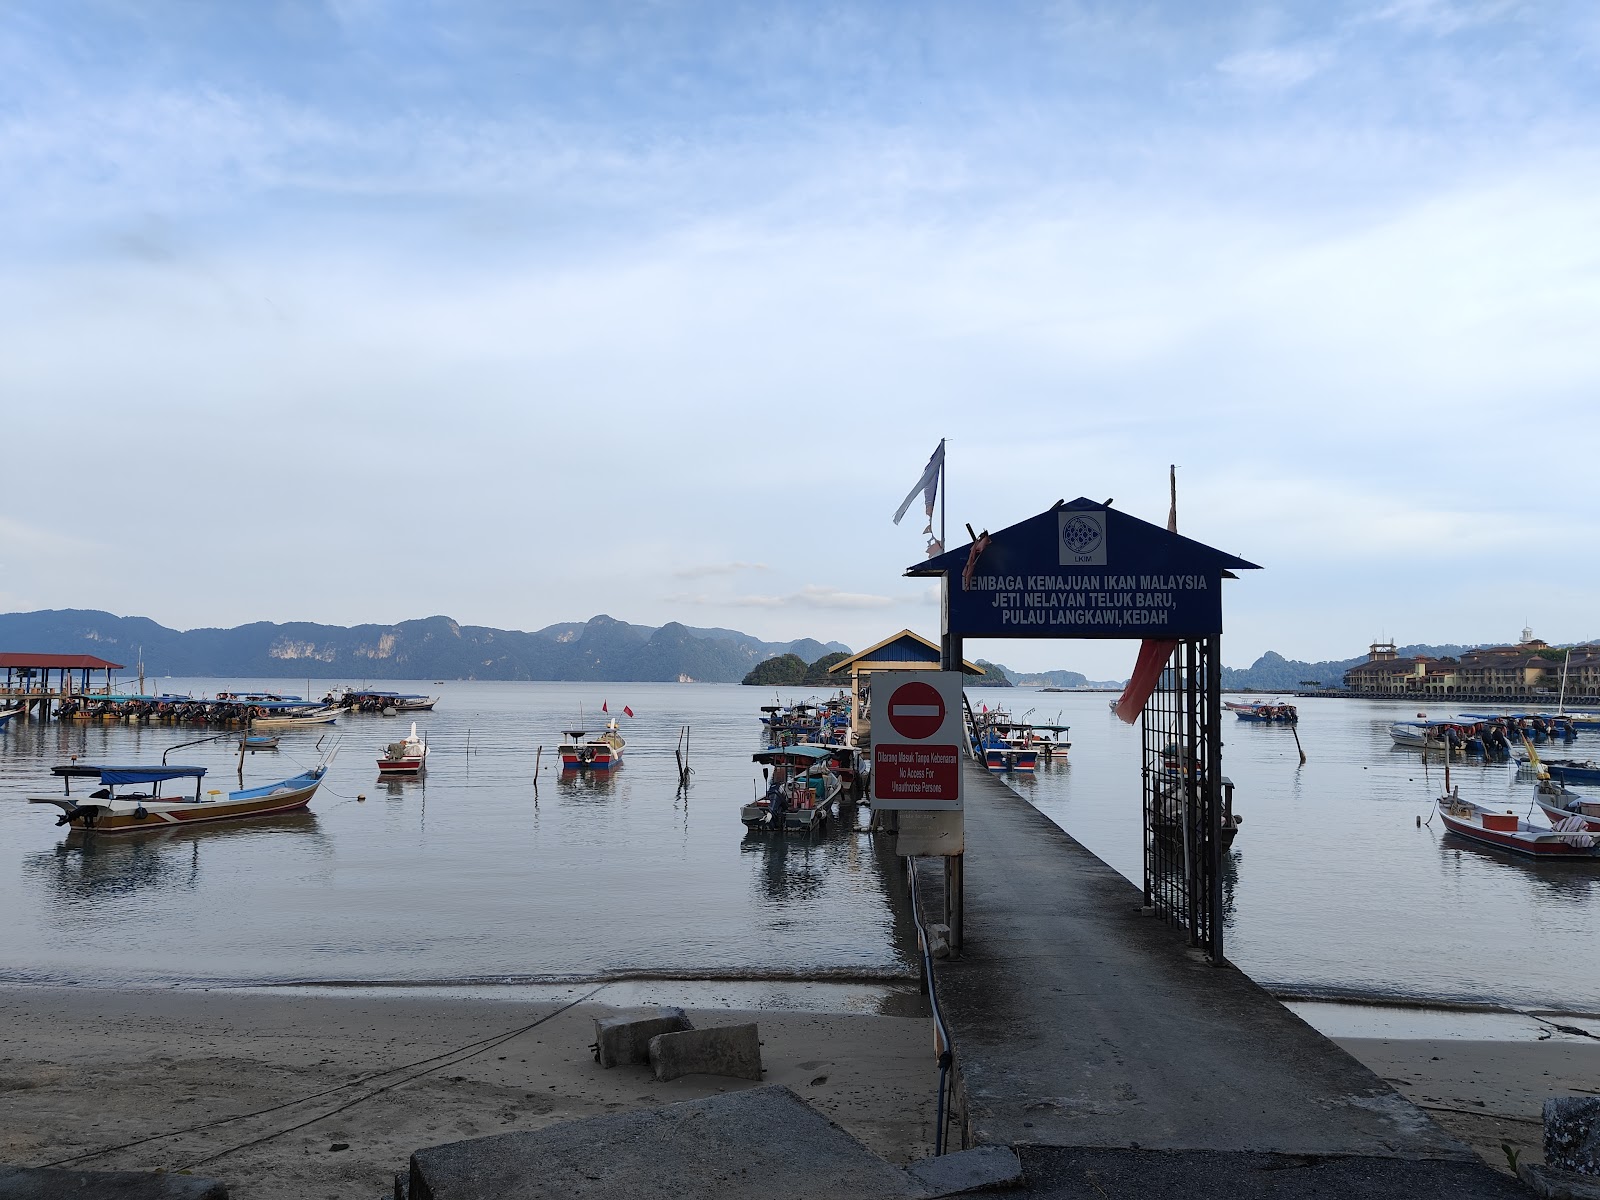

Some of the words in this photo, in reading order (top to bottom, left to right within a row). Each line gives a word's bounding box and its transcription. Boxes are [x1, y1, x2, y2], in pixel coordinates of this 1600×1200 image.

[1074, 555, 1093, 563] LKIM
[1027, 575, 1100, 590] KEMAJUAN
[1104, 575, 1136, 590] IKAN
[1140, 575, 1208, 590] MALAYSIA
[992, 593, 1020, 607] JETI
[1024, 593, 1085, 607] NELAYAN
[1089, 593, 1133, 607] TELUK
[1136, 593, 1176, 610] BARU,
[1002, 610, 1046, 624] PULAU
[877, 751, 898, 765] Dilarang
[898, 752, 914, 763] Masuk
[915, 752, 930, 765] Tanpa
[930, 753, 957, 764] Kebenaran
[899, 767, 906, 778] No
[907, 767, 925, 779] Access
[925, 768, 935, 779] For
[891, 781, 921, 793] Unauthorise
[921, 782, 942, 793] Persons
